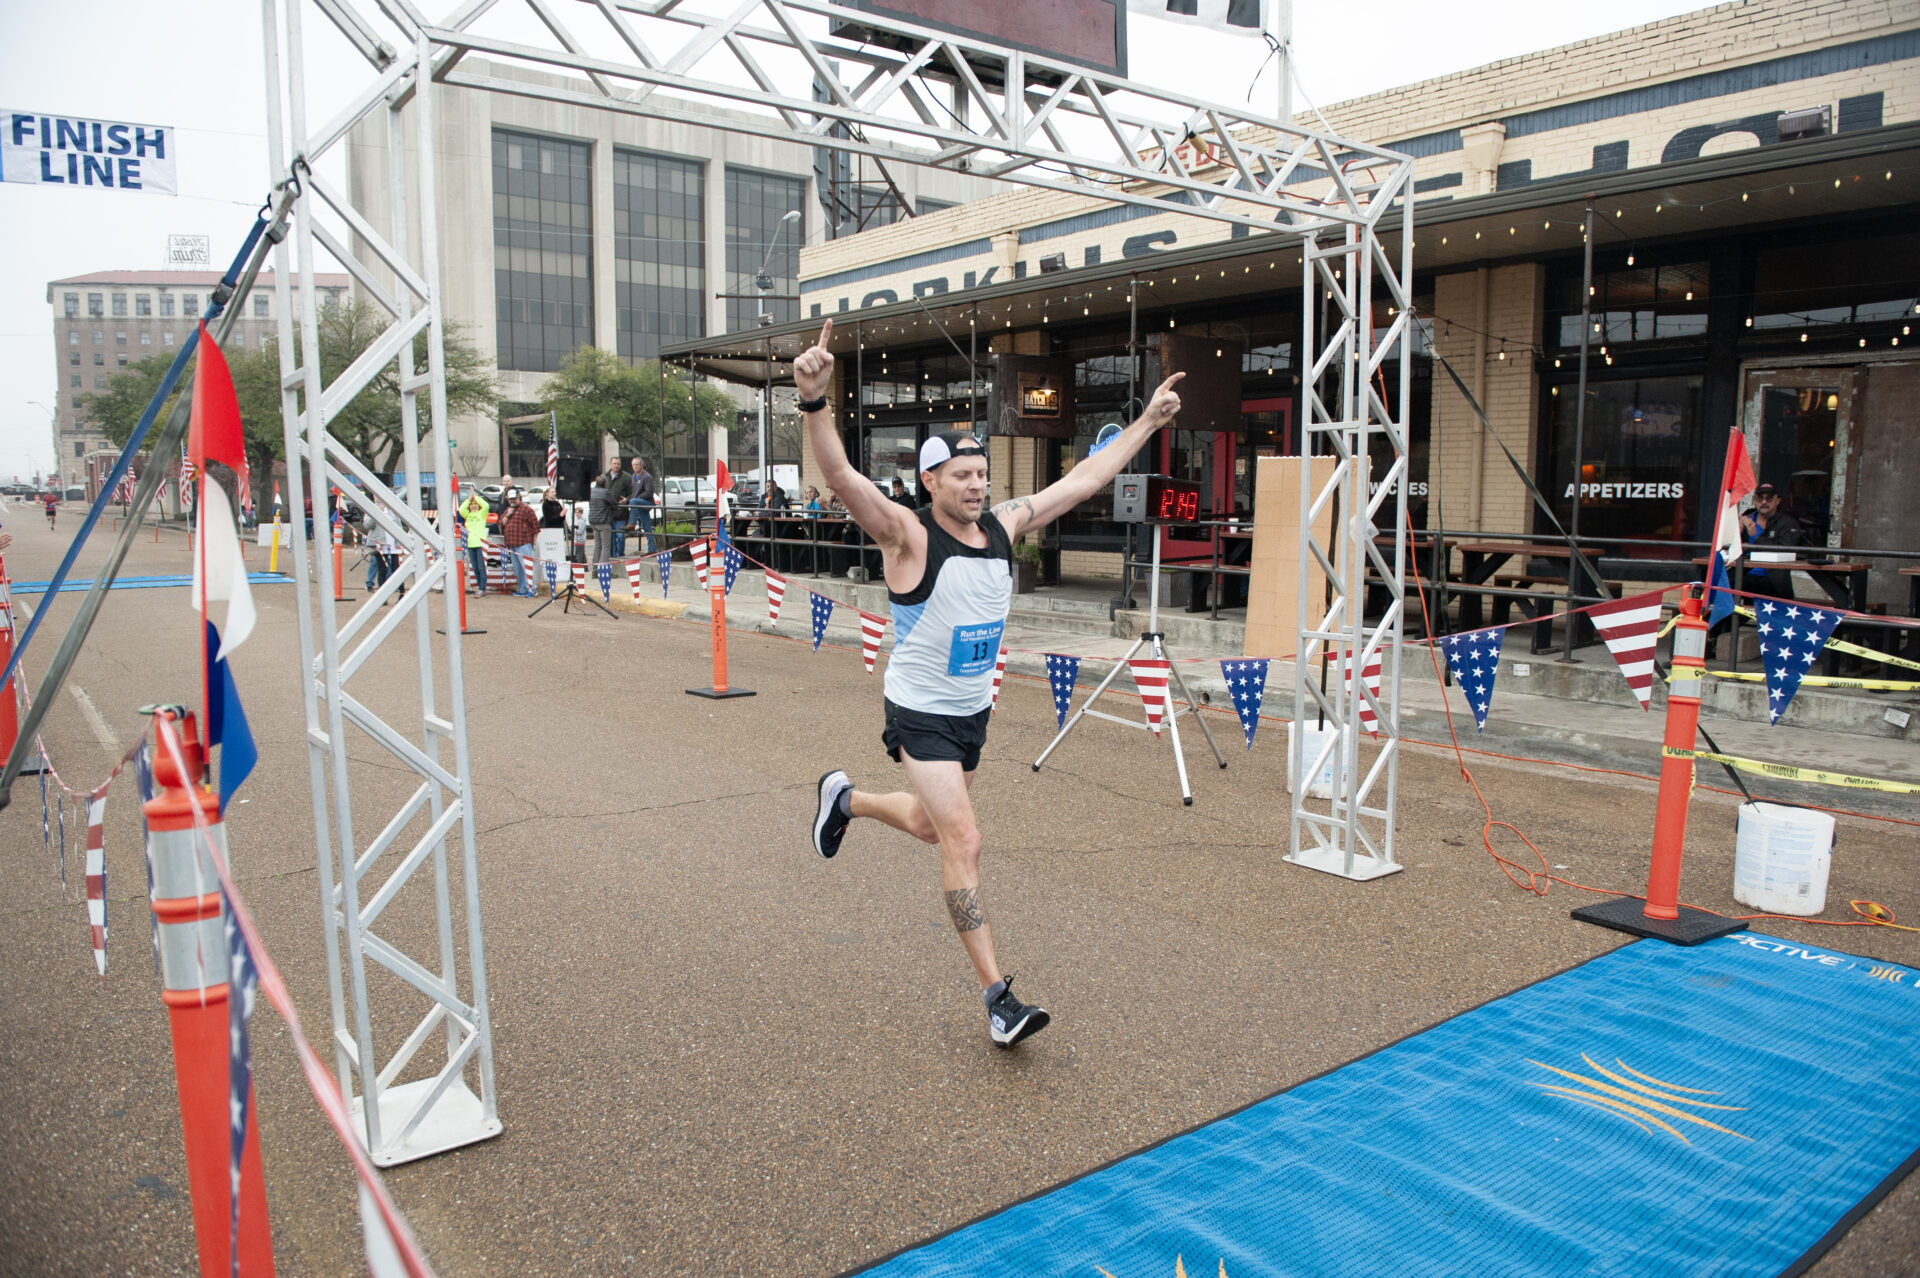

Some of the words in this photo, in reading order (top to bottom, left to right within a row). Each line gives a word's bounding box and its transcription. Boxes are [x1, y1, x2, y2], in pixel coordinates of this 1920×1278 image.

[11, 114, 165, 160] FINISH
[40, 151, 143, 190] LINE
[1564, 482, 1684, 499] APPETIZERS
[977, 628, 988, 636] the
[972, 642, 988, 661] 13
[1726, 934, 1846, 967] ACTIVE
